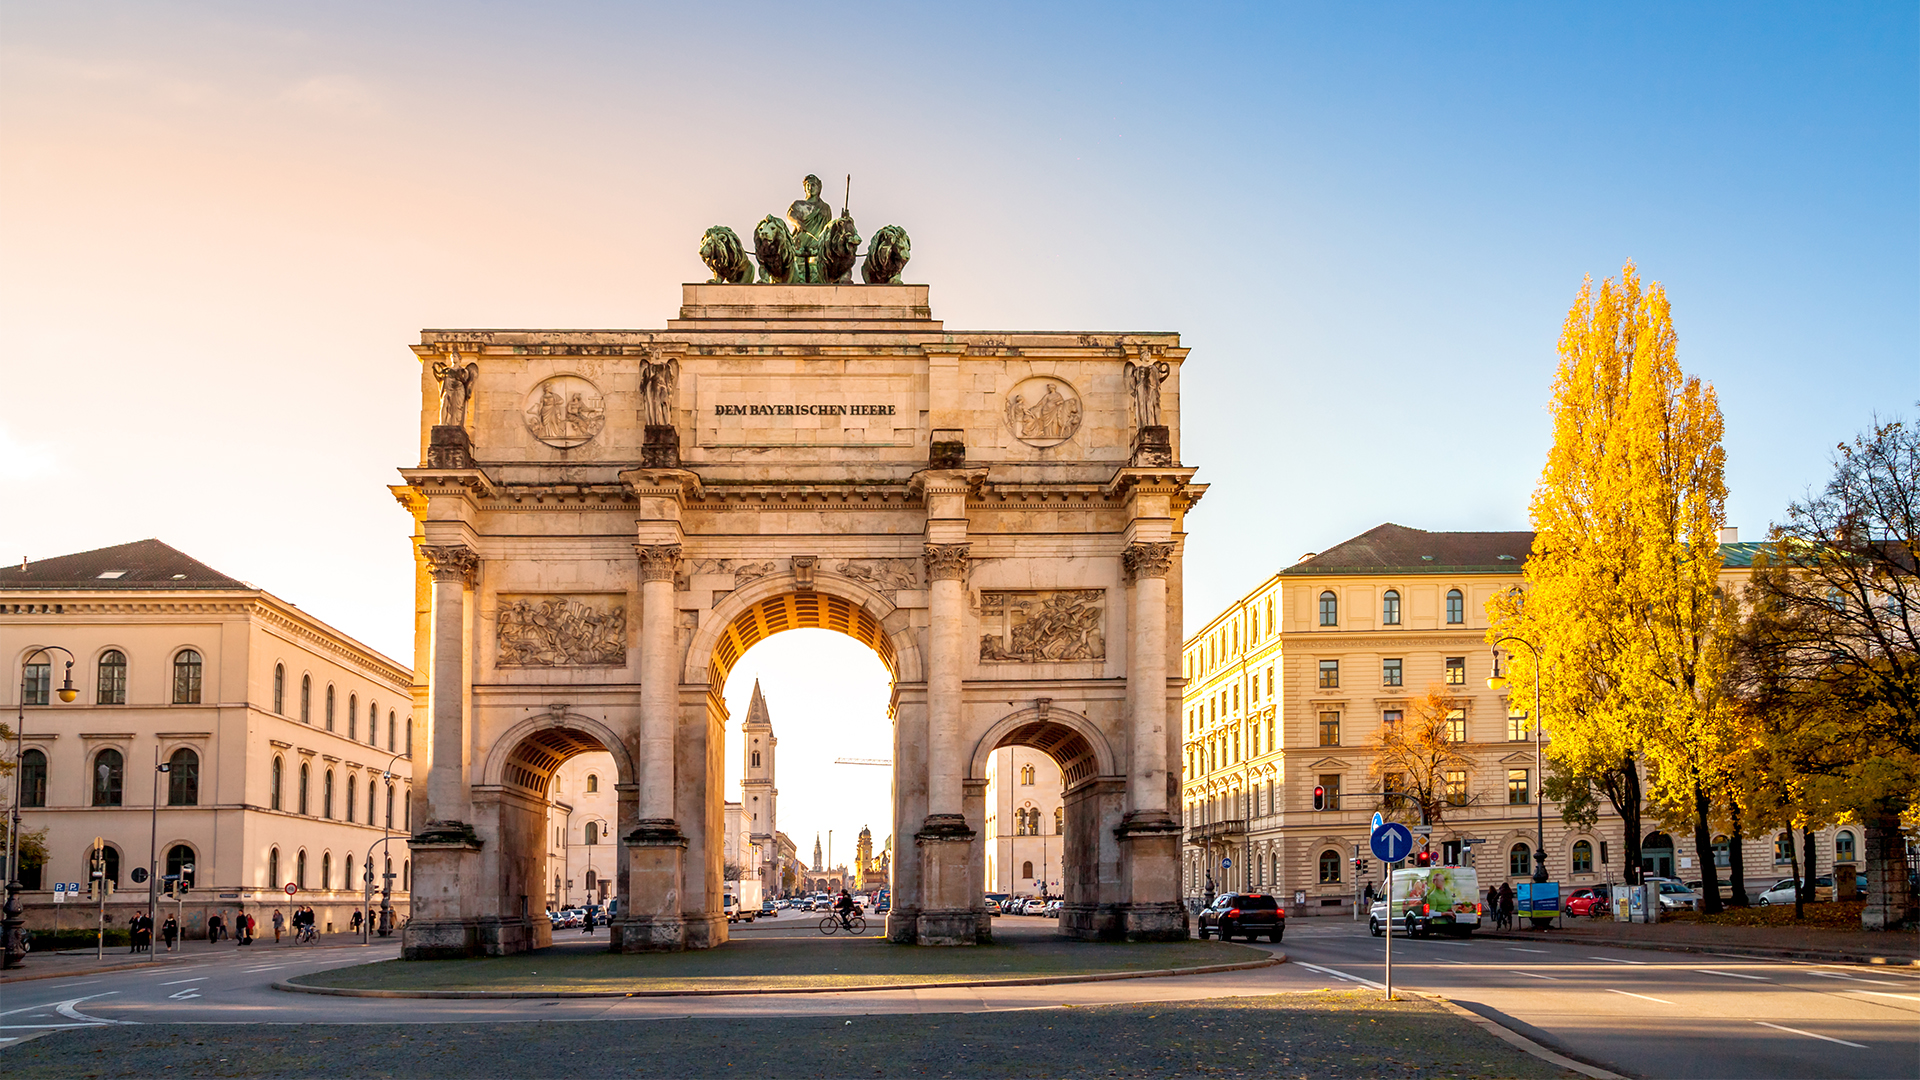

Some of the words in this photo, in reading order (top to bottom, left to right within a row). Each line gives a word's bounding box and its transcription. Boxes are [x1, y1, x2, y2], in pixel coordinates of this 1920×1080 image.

[715, 405, 747, 415] DEM
[750, 405, 847, 415] BAYERISCHEN
[850, 405, 896, 415] HEERE
